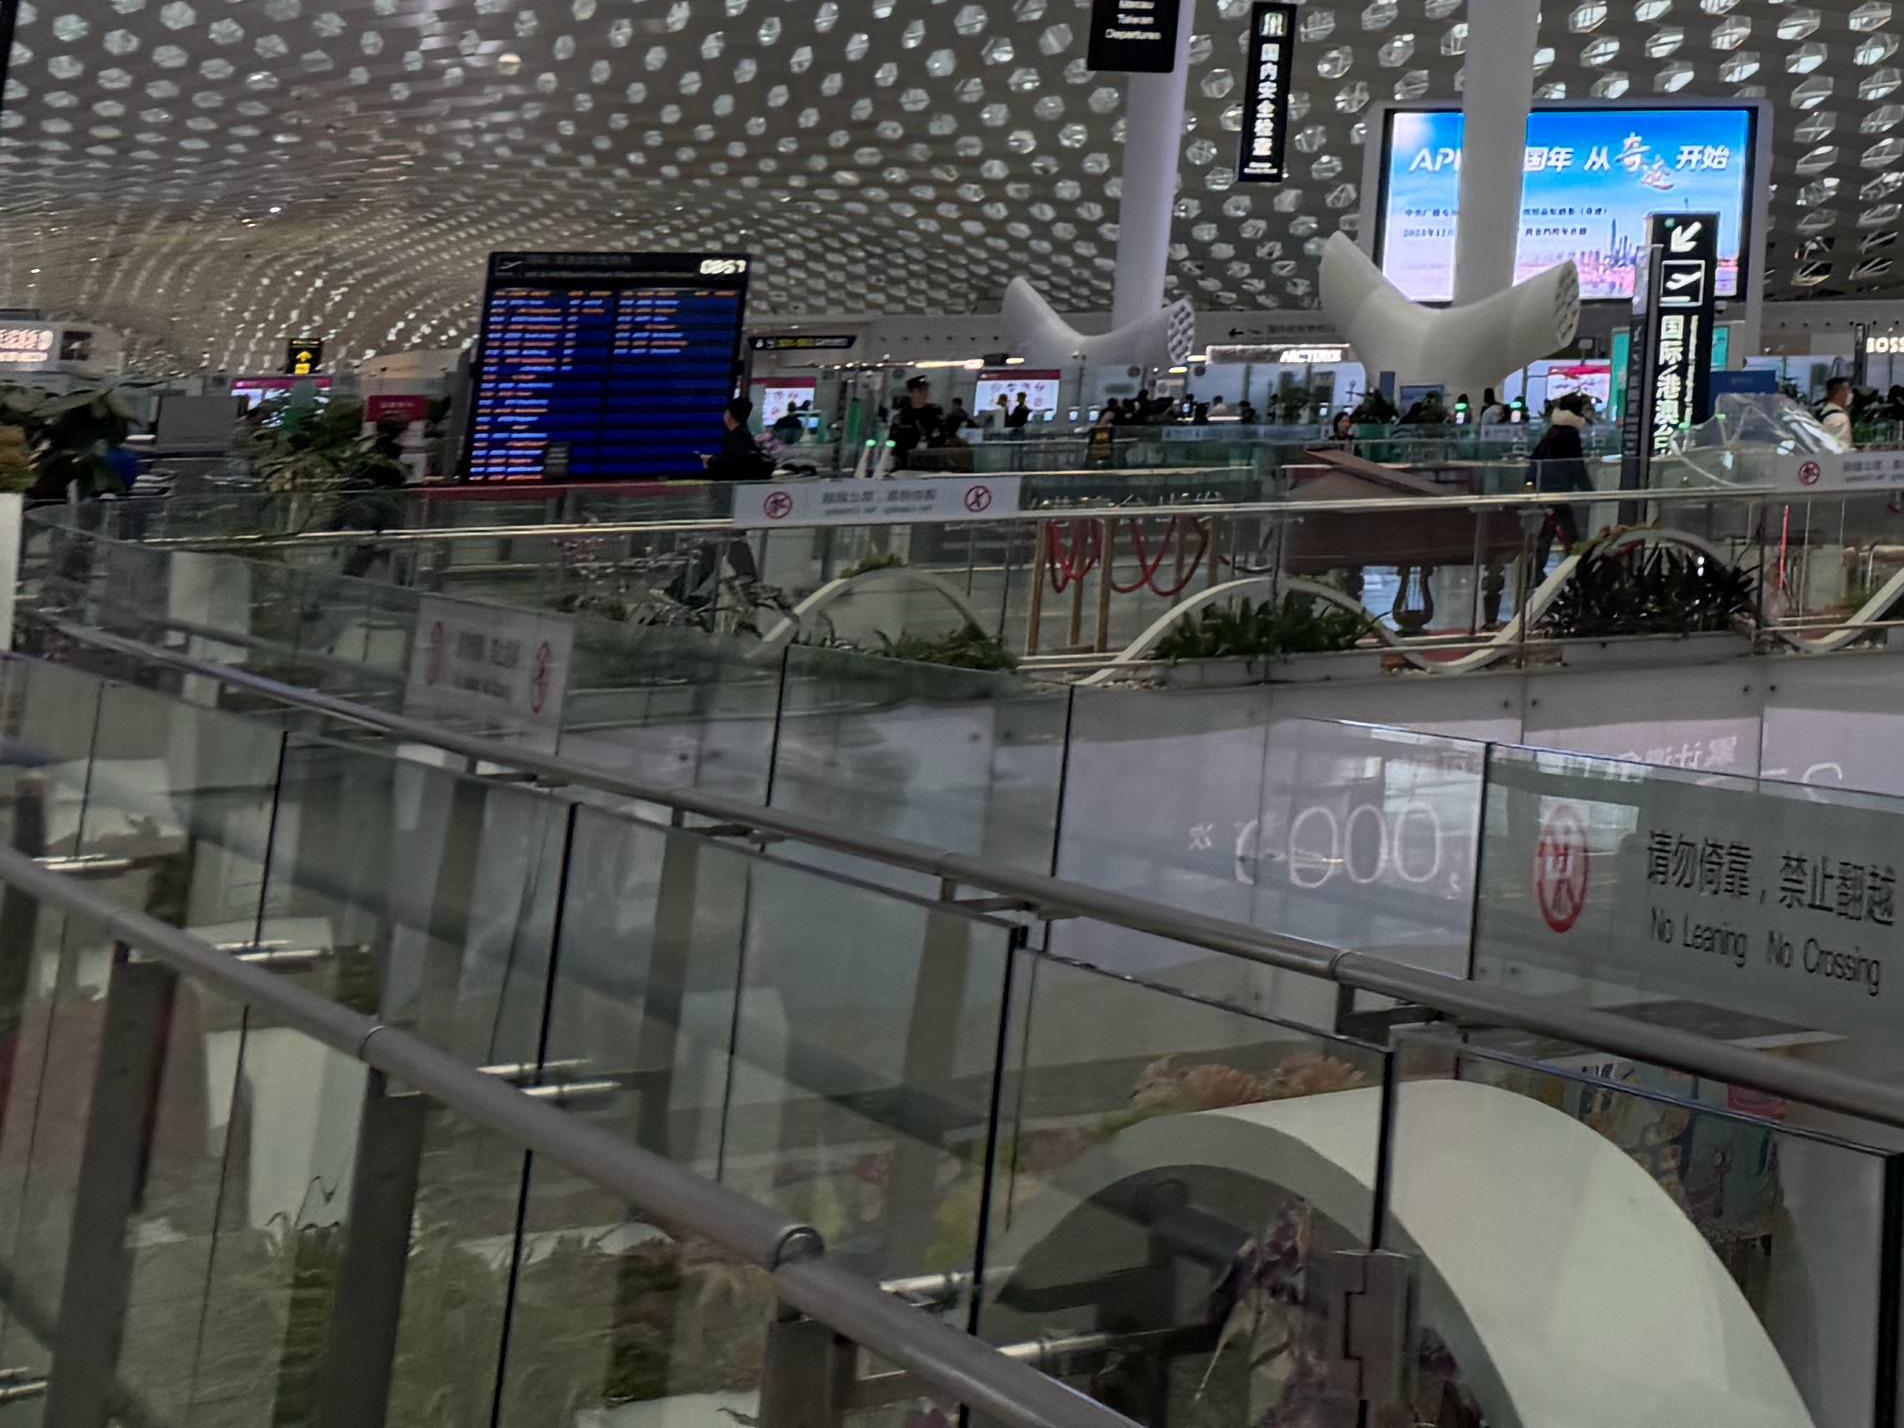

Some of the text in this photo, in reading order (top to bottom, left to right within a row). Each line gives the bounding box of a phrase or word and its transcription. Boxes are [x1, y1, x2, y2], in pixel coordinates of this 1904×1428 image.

[1651, 906, 1881, 998] No Leaning No Crossing
